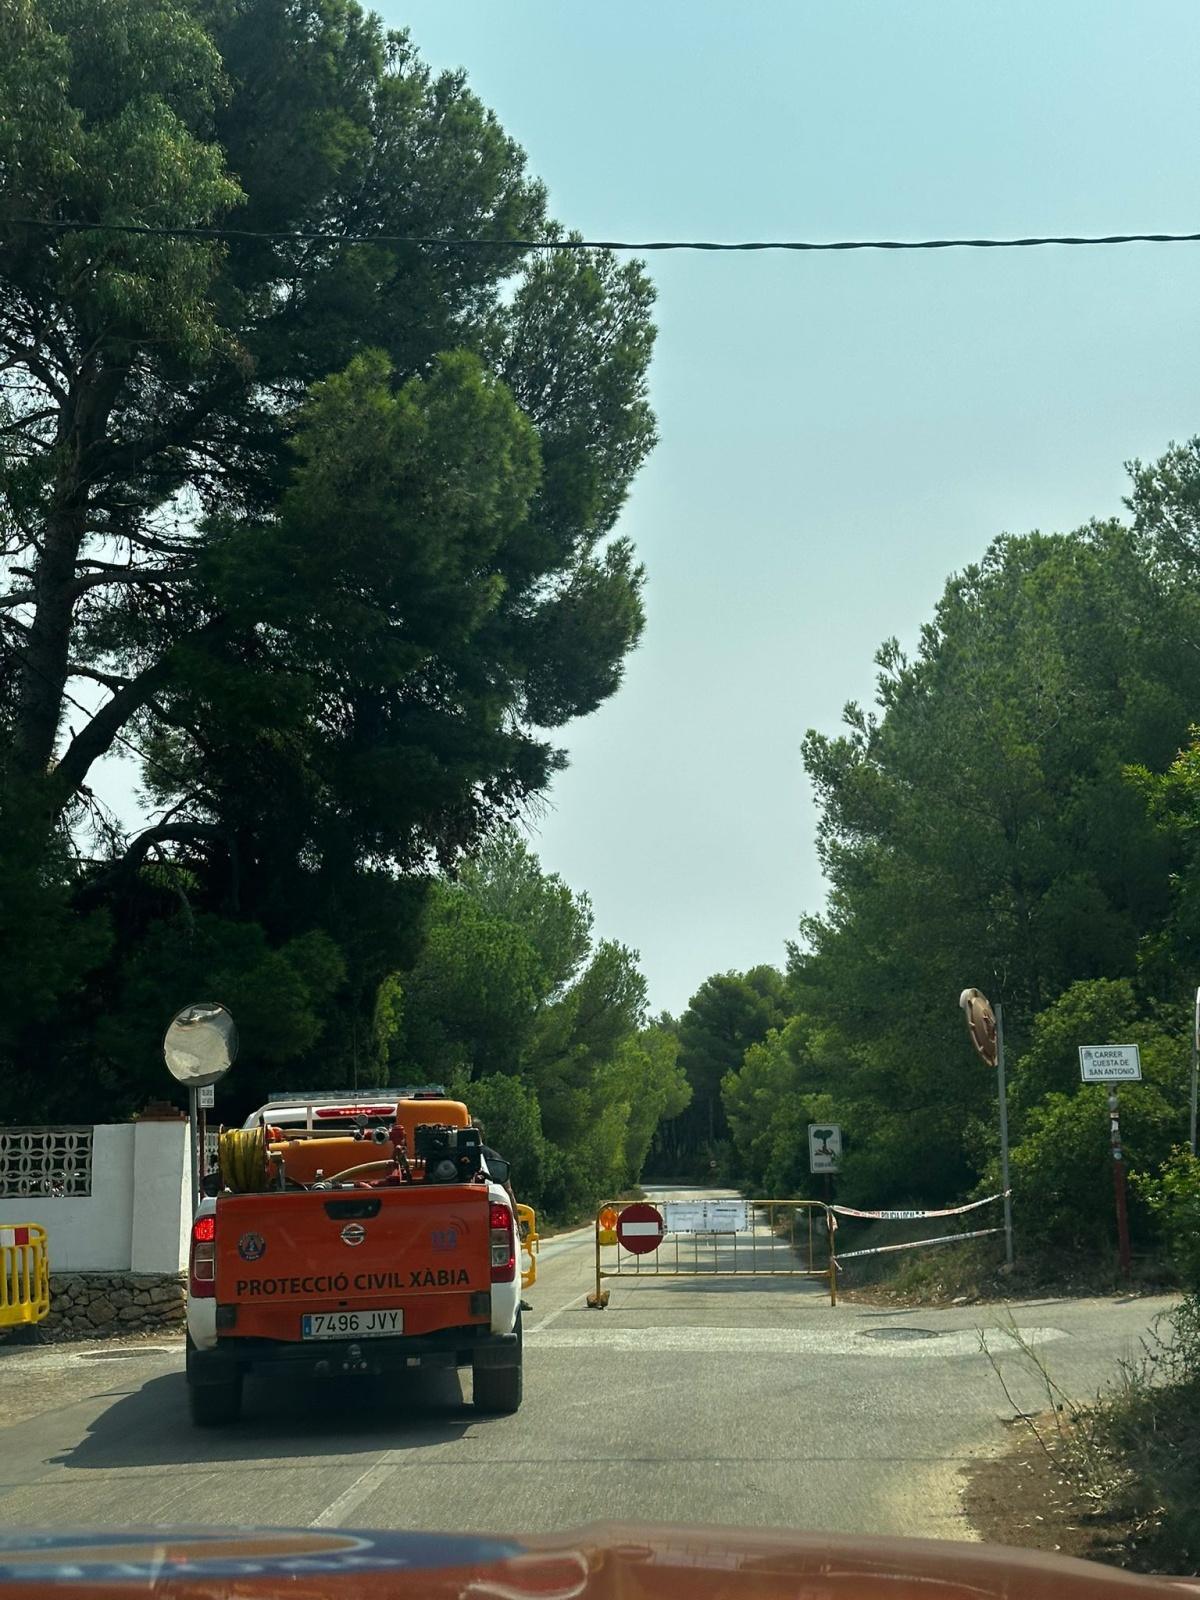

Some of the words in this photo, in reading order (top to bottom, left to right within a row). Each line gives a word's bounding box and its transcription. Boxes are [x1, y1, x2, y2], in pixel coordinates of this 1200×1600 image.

[236, 1272, 349, 1296] PROTECCIÓ
[354, 1272, 405, 1290] CIVIL
[409, 1267, 470, 1288] XÀBIA
[315, 1314, 360, 1334] 7496
[366, 1311, 398, 1330] JVY
